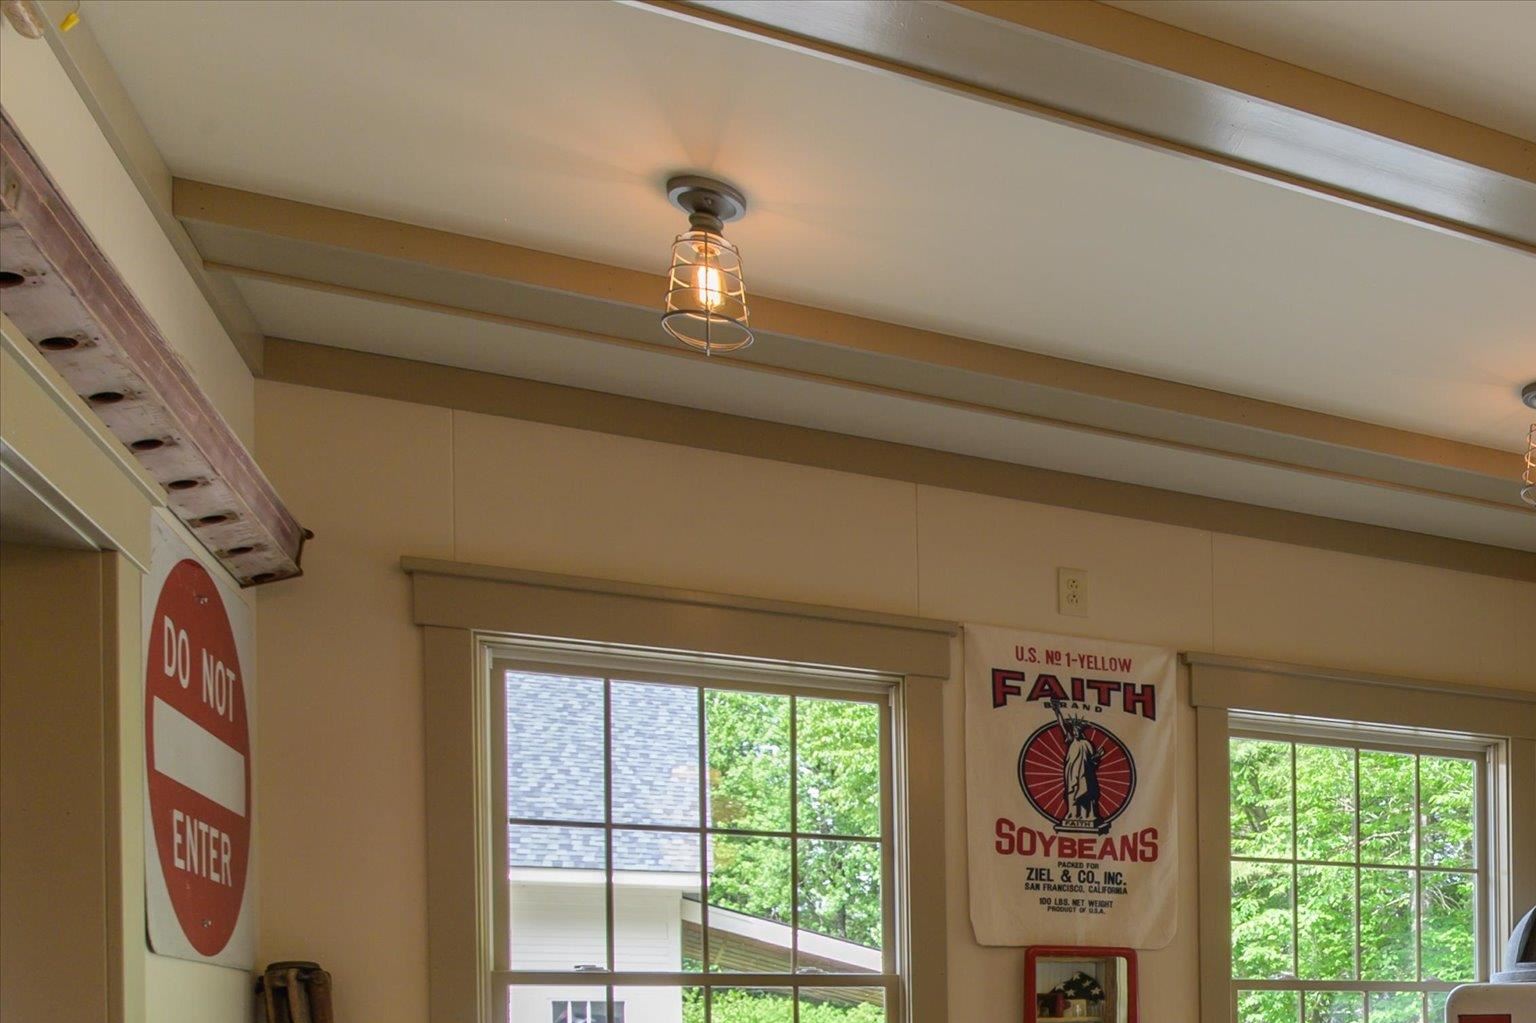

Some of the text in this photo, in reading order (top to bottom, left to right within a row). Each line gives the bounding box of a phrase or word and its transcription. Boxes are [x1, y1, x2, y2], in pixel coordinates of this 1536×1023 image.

[164, 615, 236, 722] DO NOT
[1015, 645, 1040, 664] U.S.
[1065, 652, 1132, 672] 1-YELLOW
[991, 668, 1156, 721] FAITH
[1044, 701, 1103, 713] BRAND
[172, 808, 232, 887] ENTER
[994, 818, 1158, 863] SOYBEANS
[1026, 867, 1054, 882] ZIEL
[1061, 869, 1071, 883] &
[1104, 871, 1127, 886] INC.
[1057, 861, 1084, 869] PACKED
[1024, 882, 1040, 891] SAN
[1088, 885, 1128, 894] CALIFORNIA
[1072, 899, 1084, 907] NET
[1088, 900, 1113, 908] WEIGHT
